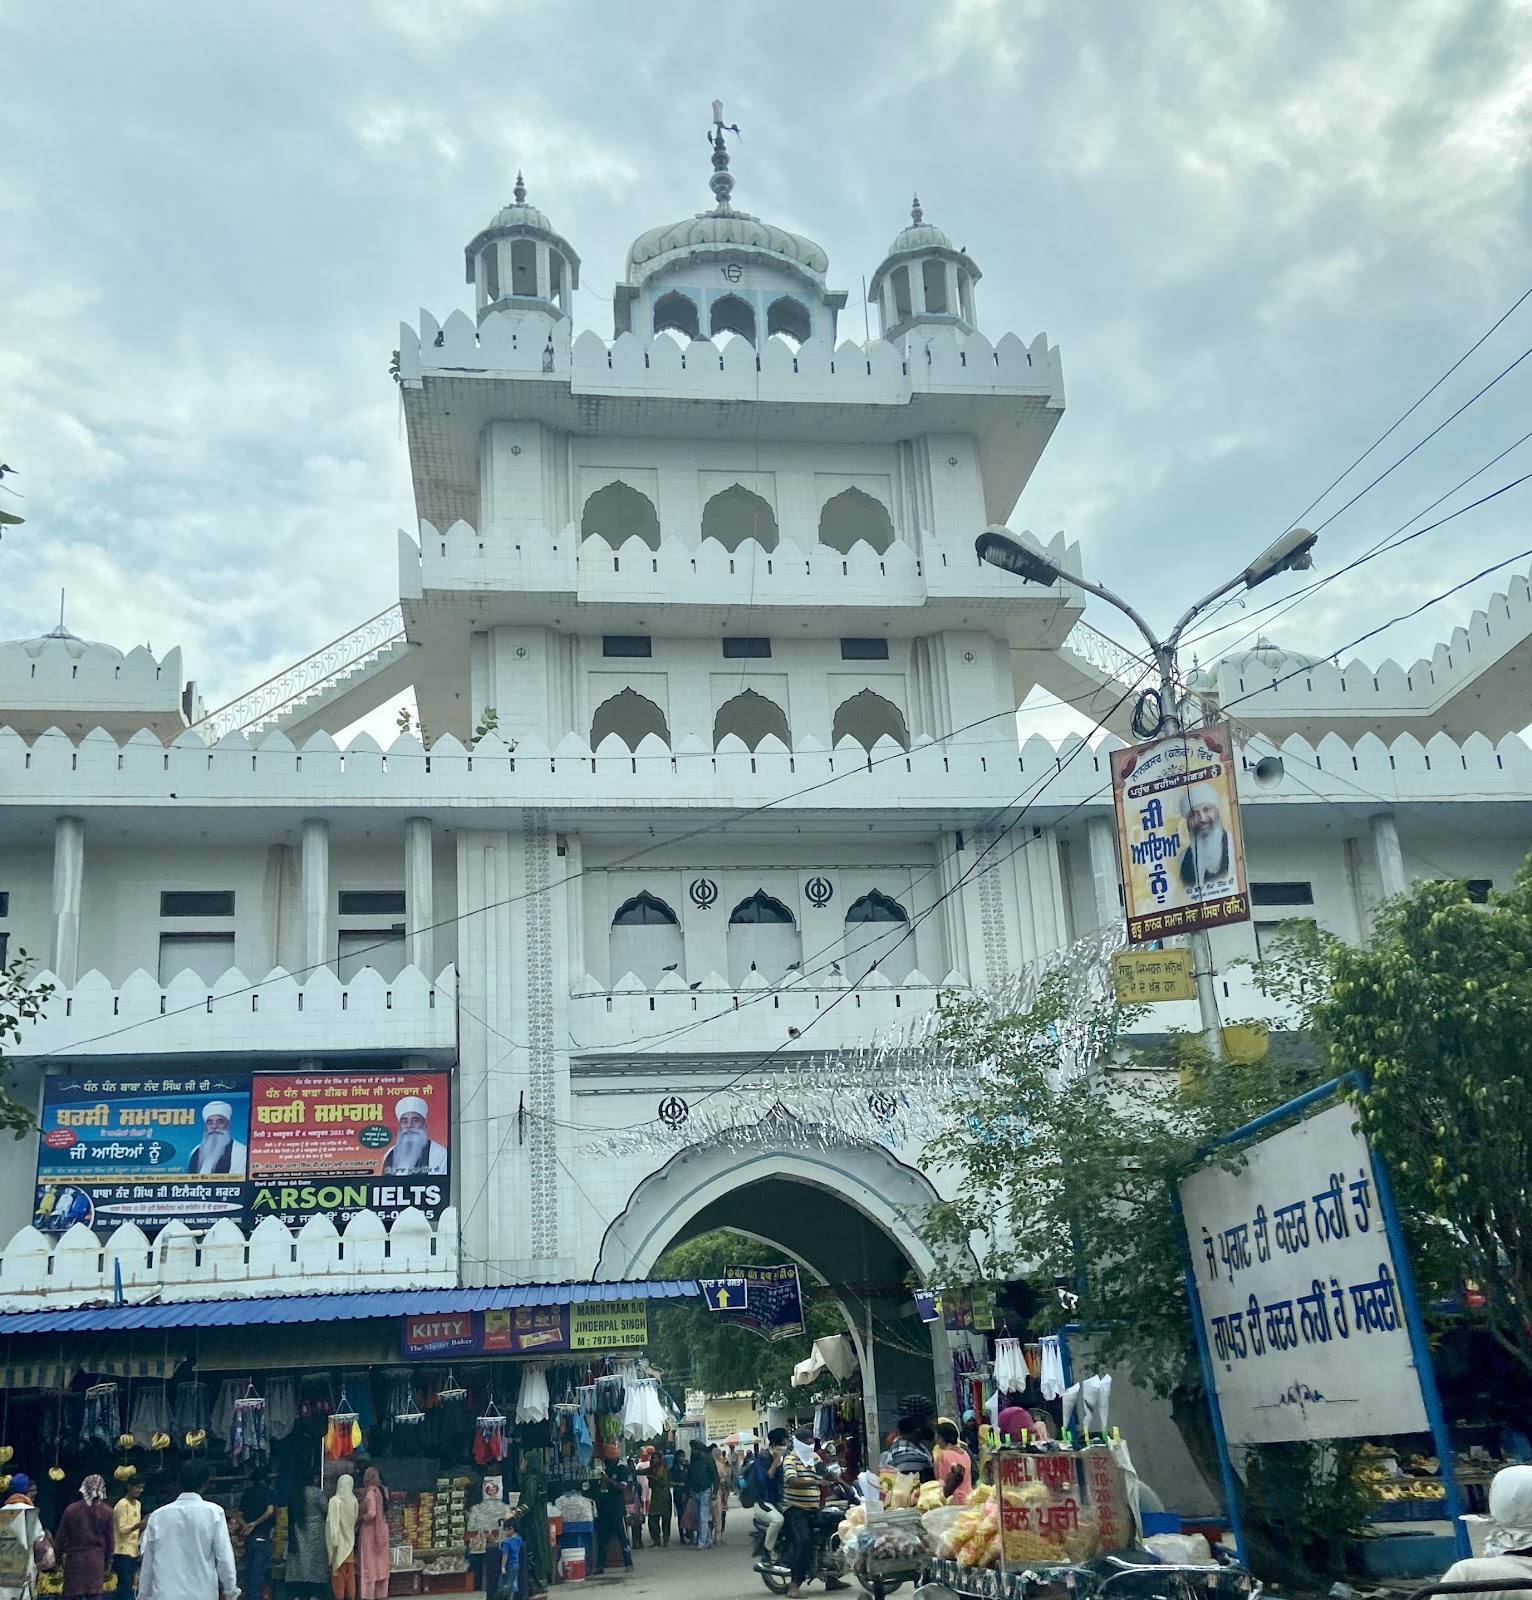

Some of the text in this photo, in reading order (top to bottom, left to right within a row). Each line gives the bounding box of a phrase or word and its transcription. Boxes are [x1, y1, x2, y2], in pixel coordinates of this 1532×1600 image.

[1131, 754, 1162, 782] ਨਾਨਕਸਰ
[1140, 798, 1164, 831] ਜੀ
[1131, 828, 1180, 865] ਆਇਆਂ
[1149, 863, 1168, 904] ਨੂੰ
[1130, 921, 1142, 939] ਗੁਰੂ
[1144, 917, 1162, 932] ਨਾਨਕ
[1164, 912, 1183, 928] ਸਮਾਜ
[1136, 961, 1161, 975] ਸਿਮਰਨ
[1164, 980, 1176, 993] ਹਨ
[83, 1079, 211, 1092] ਧੰਨ ਧੰਨ ਬਾਬਾ ਨੰਦ ਸਿੰਘ ਜੀ ਦੀ
[266, 1088, 280, 1099] ਧੰਨ
[284, 1088, 298, 1098] ਧੰਨ
[302, 1088, 321, 1098] ਬਾਬਾ
[352, 1086, 370, 1097] ਸਿੰਘ
[373, 1085, 384, 1097] ਜੀ
[387, 1086, 420, 1096] ਮਹਾਰਾਜ
[423, 1084, 433, 1096] ਜੀ
[56, 1103, 196, 1127] ਬਰਸੀ ਸਮਾਗਮ
[257, 1100, 384, 1124] ਬਰਸੀ ਸਮਾਗਮ
[70, 1141, 161, 1164] ਜੀ ਆਇਆਂ ਨੂੰ
[92, 1188, 112, 1199] ਬਾਬਾ
[115, 1186, 130, 1198] ਨੰਦ
[133, 1186, 154, 1198] ਸਿੰਘ
[157, 1185, 168, 1198] ਜੀ
[215, 1186, 241, 1202] ਸਕੂਟਰ
[372, 1185, 441, 1206] IELTS
[1201, 1226, 1219, 1280] ਜੇ
[1253, 1204, 1271, 1264] ਦੀ
[1273, 1200, 1310, 1254] ਕਦਰ
[1312, 1171, 1350, 1243] ਨਹੀਂ
[1349, 1167, 1372, 1234] ਤਾਂ
[577, 1302, 645, 1316] MANGATRAM S/O
[1211, 1311, 1247, 1372] ਗੁਪਤ
[1247, 1294, 1266, 1356] ਦੀ
[1264, 1299, 1298, 1350] ਕਦਰ
[1297, 1279, 1333, 1345] ਨਹੀਂ
[1349, 1262, 1402, 1334] ਸਕਦੀ
[412, 1320, 464, 1338] KITTY
[575, 1318, 646, 1333] JINDERPAL SINGH
[409, 1338, 473, 1352] The Master Baker
[577, 1337, 585, 1346] M
[592, 1334, 645, 1346] 79738-18506
